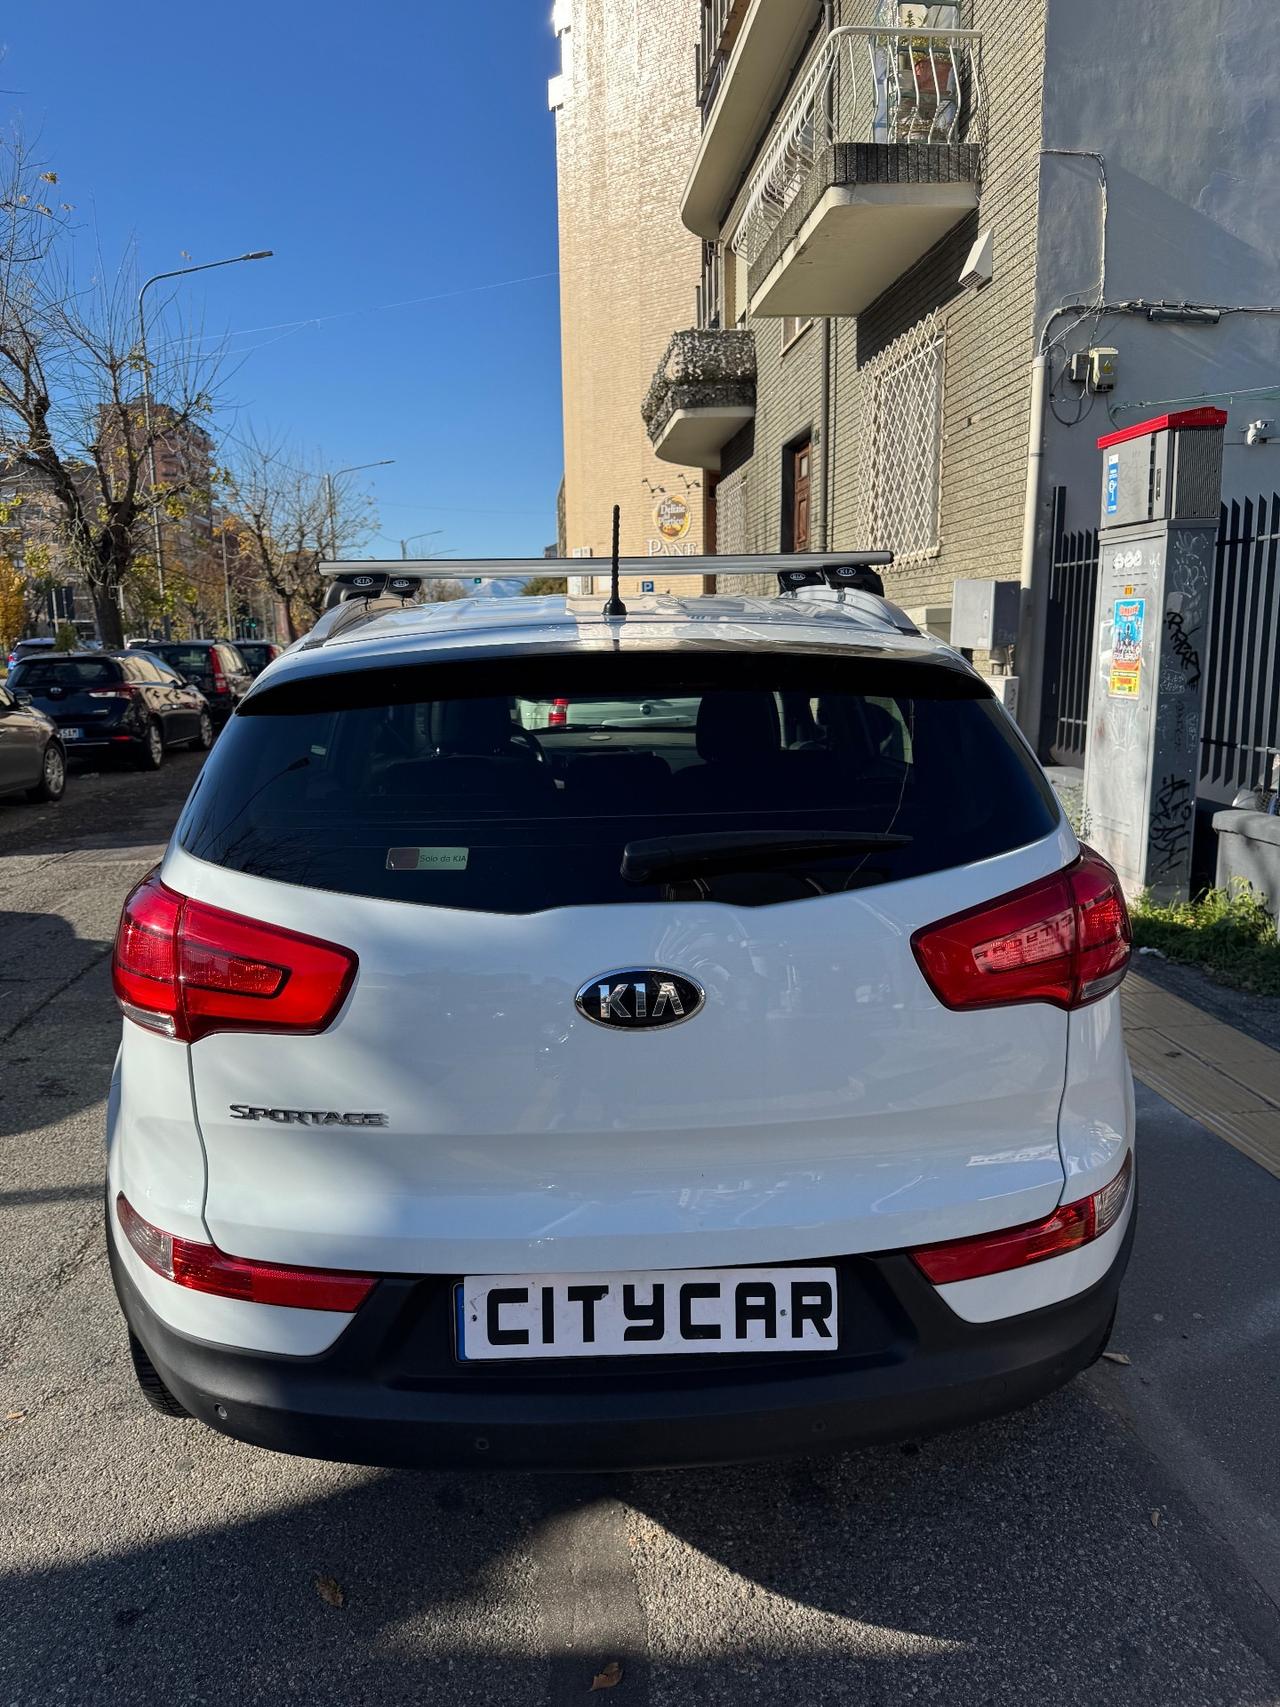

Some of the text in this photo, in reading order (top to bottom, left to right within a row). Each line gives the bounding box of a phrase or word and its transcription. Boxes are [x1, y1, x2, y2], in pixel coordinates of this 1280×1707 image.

[648, 539, 697, 556] PANE
[420, 854, 467, 863] Solo da KIA
[598, 981, 685, 1019] KIA
[230, 1103, 390, 1129] SPORTAGE
[486, 1280, 833, 1346] CITYCAR
